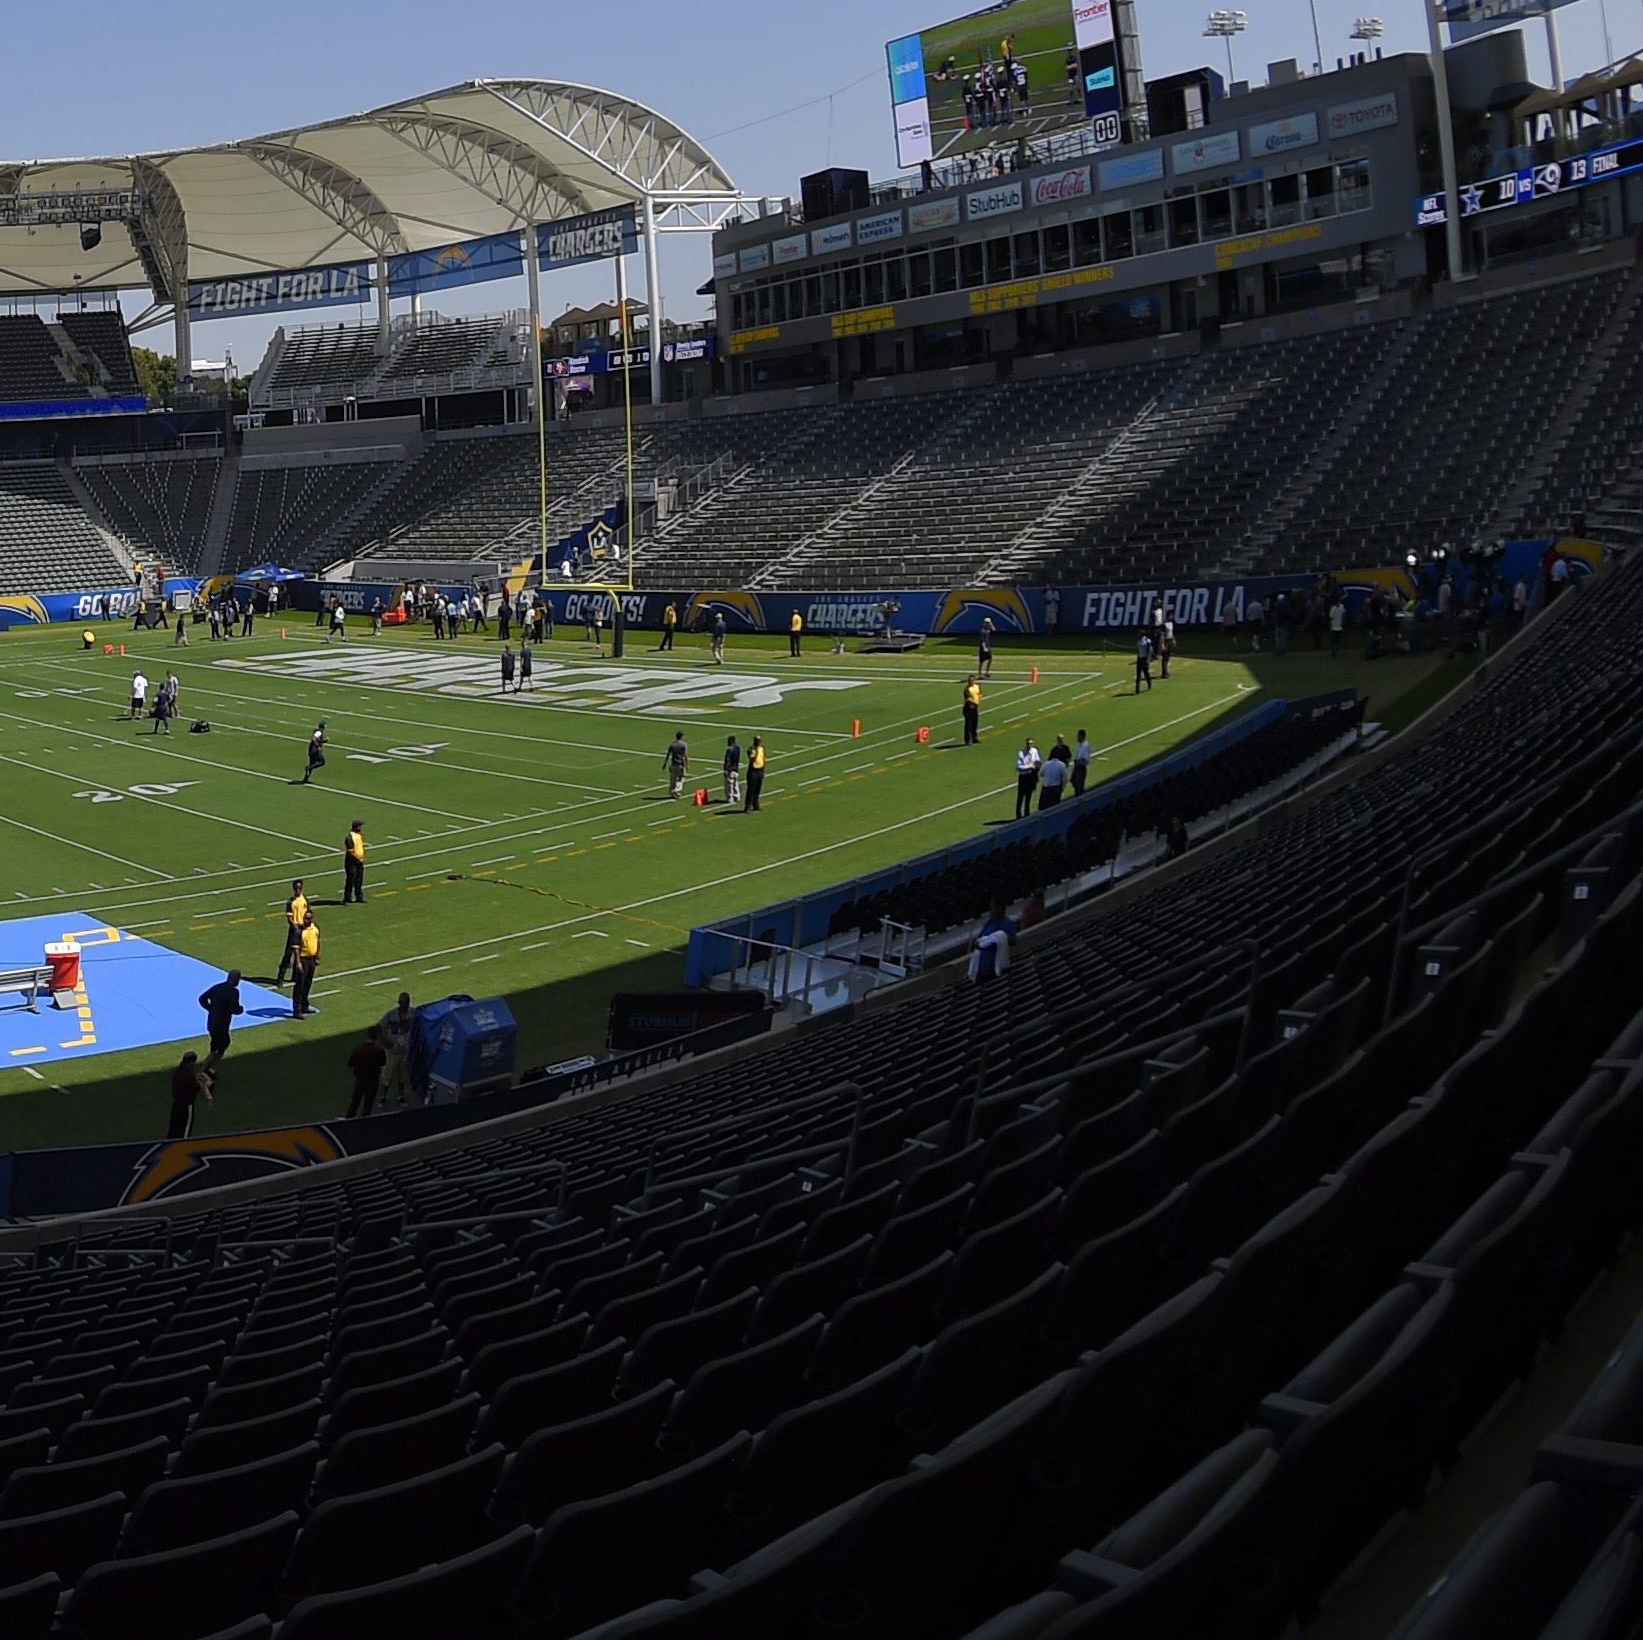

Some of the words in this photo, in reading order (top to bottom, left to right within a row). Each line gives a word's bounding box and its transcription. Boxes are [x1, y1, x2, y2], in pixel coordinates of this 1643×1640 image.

[1075, 2, 1109, 20] Frontier
[1349, 104, 1395, 125] TOYOTA
[1266, 130, 1303, 151] Corona
[1571, 160, 1587, 181] 13
[1593, 153, 1619, 175] FINAL
[1499, 180, 1515, 200] 10
[970, 190, 1020, 216] StubHub
[859, 215, 900, 232] AMERICAN
[859, 225, 894, 241] EXPRESS
[549, 221, 623, 262] CHARGERS
[200, 277, 272, 313] FIGHT
[278, 270, 325, 301] FOR
[330, 266, 360, 299] LA
[78, 595, 103, 617] GO
[566, 596, 588, 621] GO
[807, 603, 885, 629] CHARGERS
[1083, 590, 1158, 627] FIGHT
[1164, 588, 1210, 625] FOR
